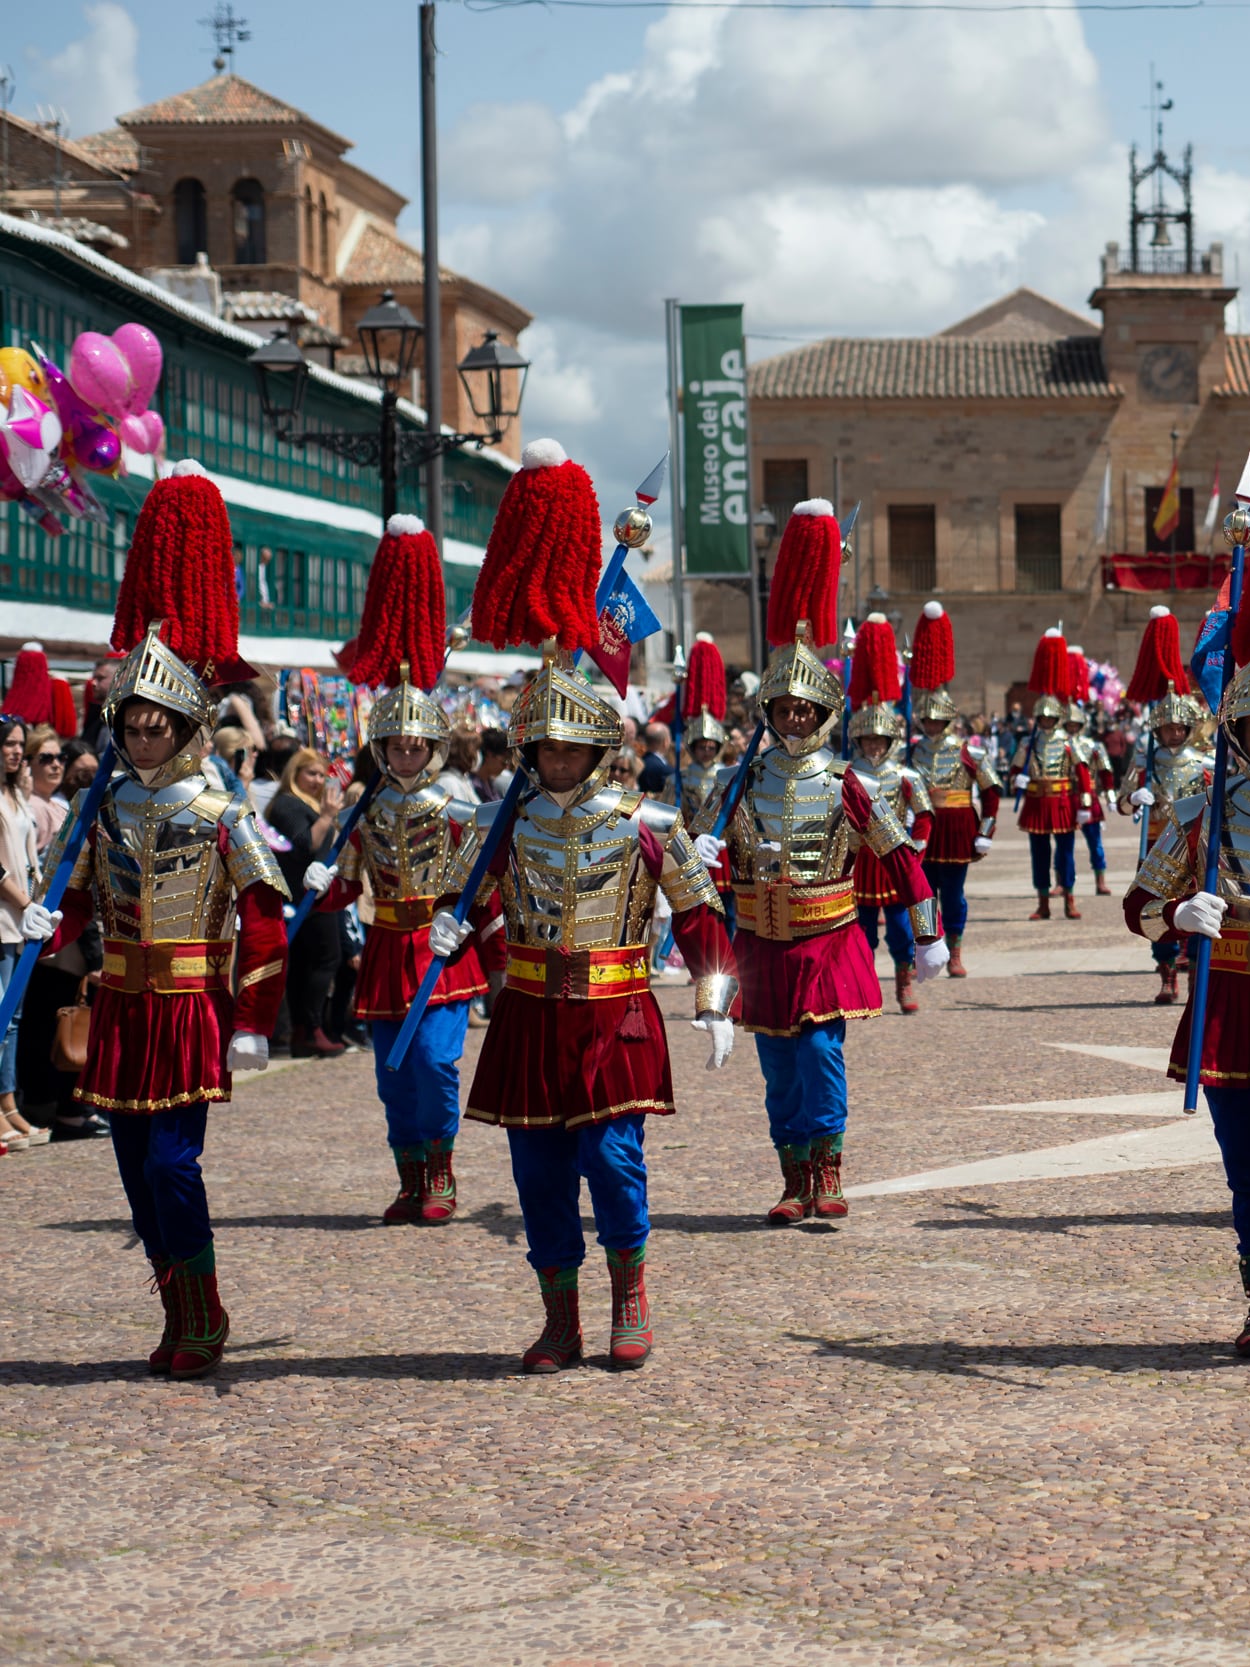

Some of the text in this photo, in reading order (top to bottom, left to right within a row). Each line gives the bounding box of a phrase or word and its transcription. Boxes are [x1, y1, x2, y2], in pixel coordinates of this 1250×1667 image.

[690, 349, 748, 525] encaje
[697, 400, 721, 525] Museo del
[802, 906, 828, 918] MBL
